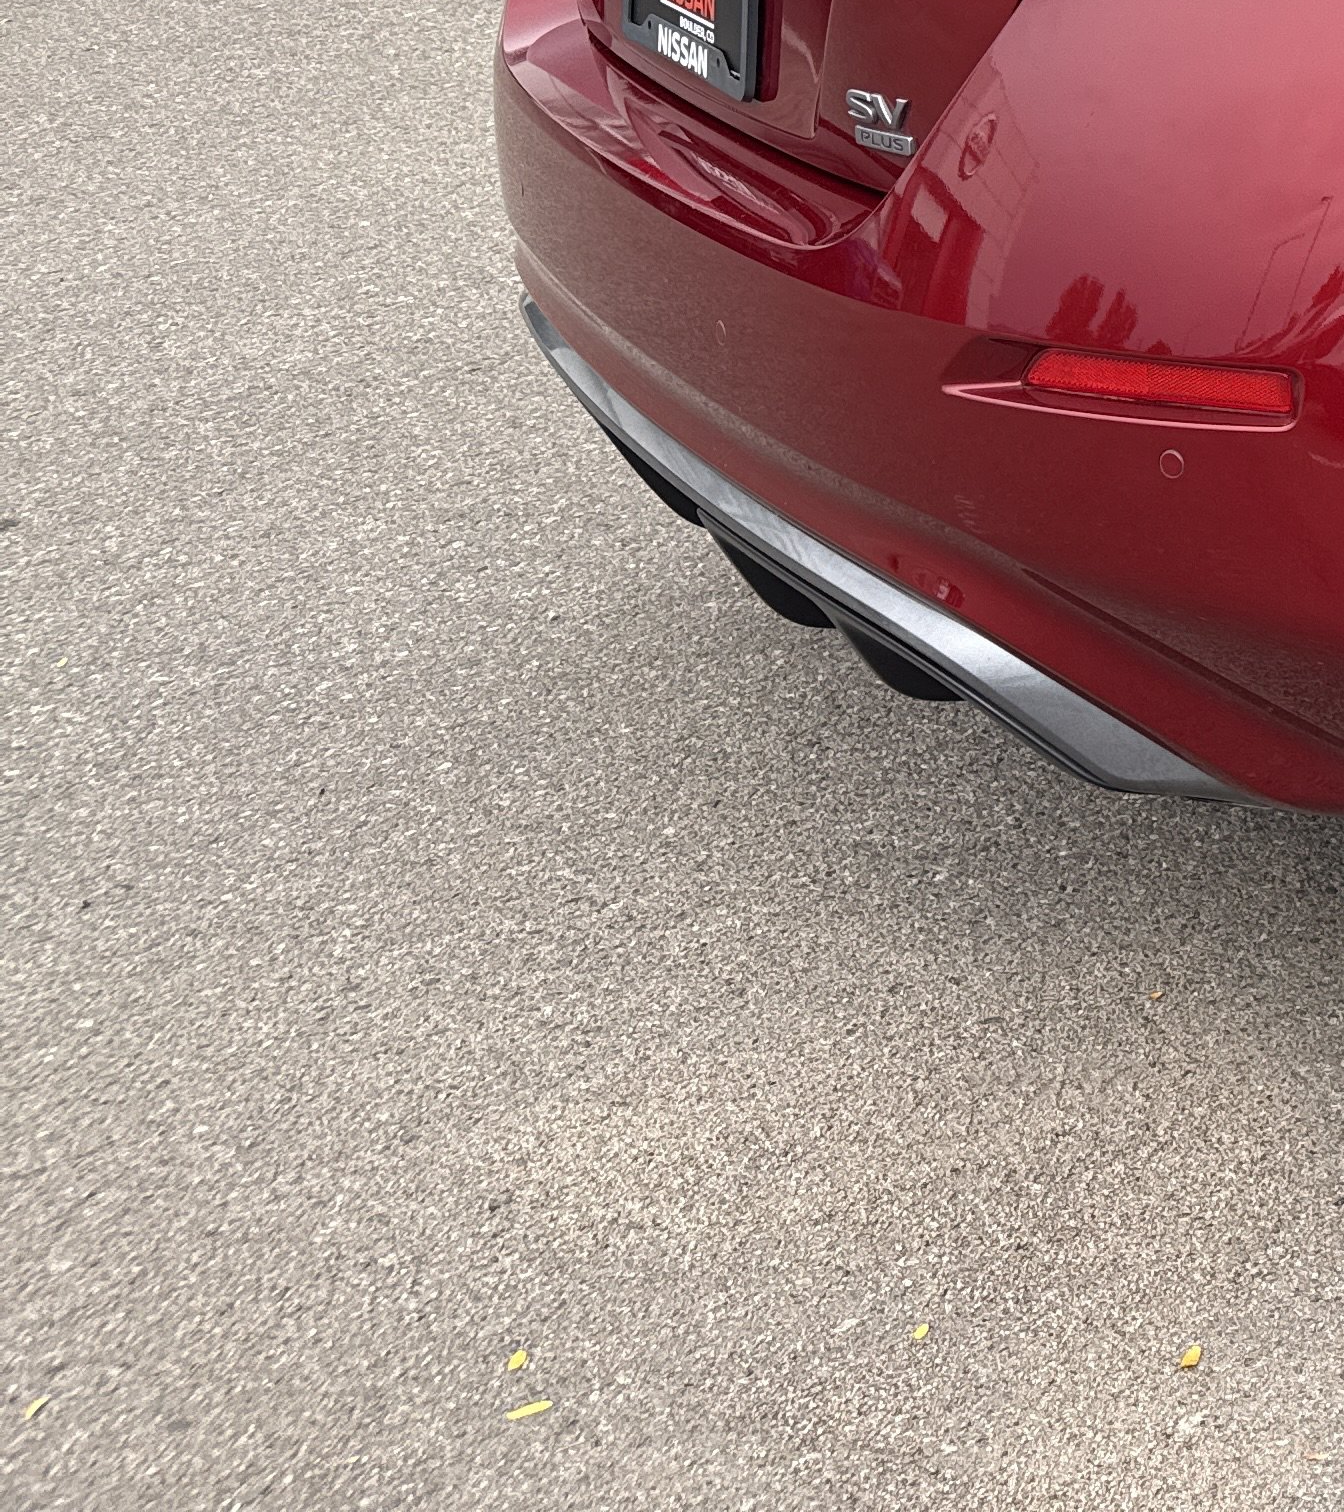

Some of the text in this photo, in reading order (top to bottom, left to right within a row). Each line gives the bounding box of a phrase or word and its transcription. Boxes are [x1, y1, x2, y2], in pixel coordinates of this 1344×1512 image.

[657, 23, 708, 79] NISSAN
[846, 88, 909, 130] SV
[860, 130, 904, 152] PLUS
